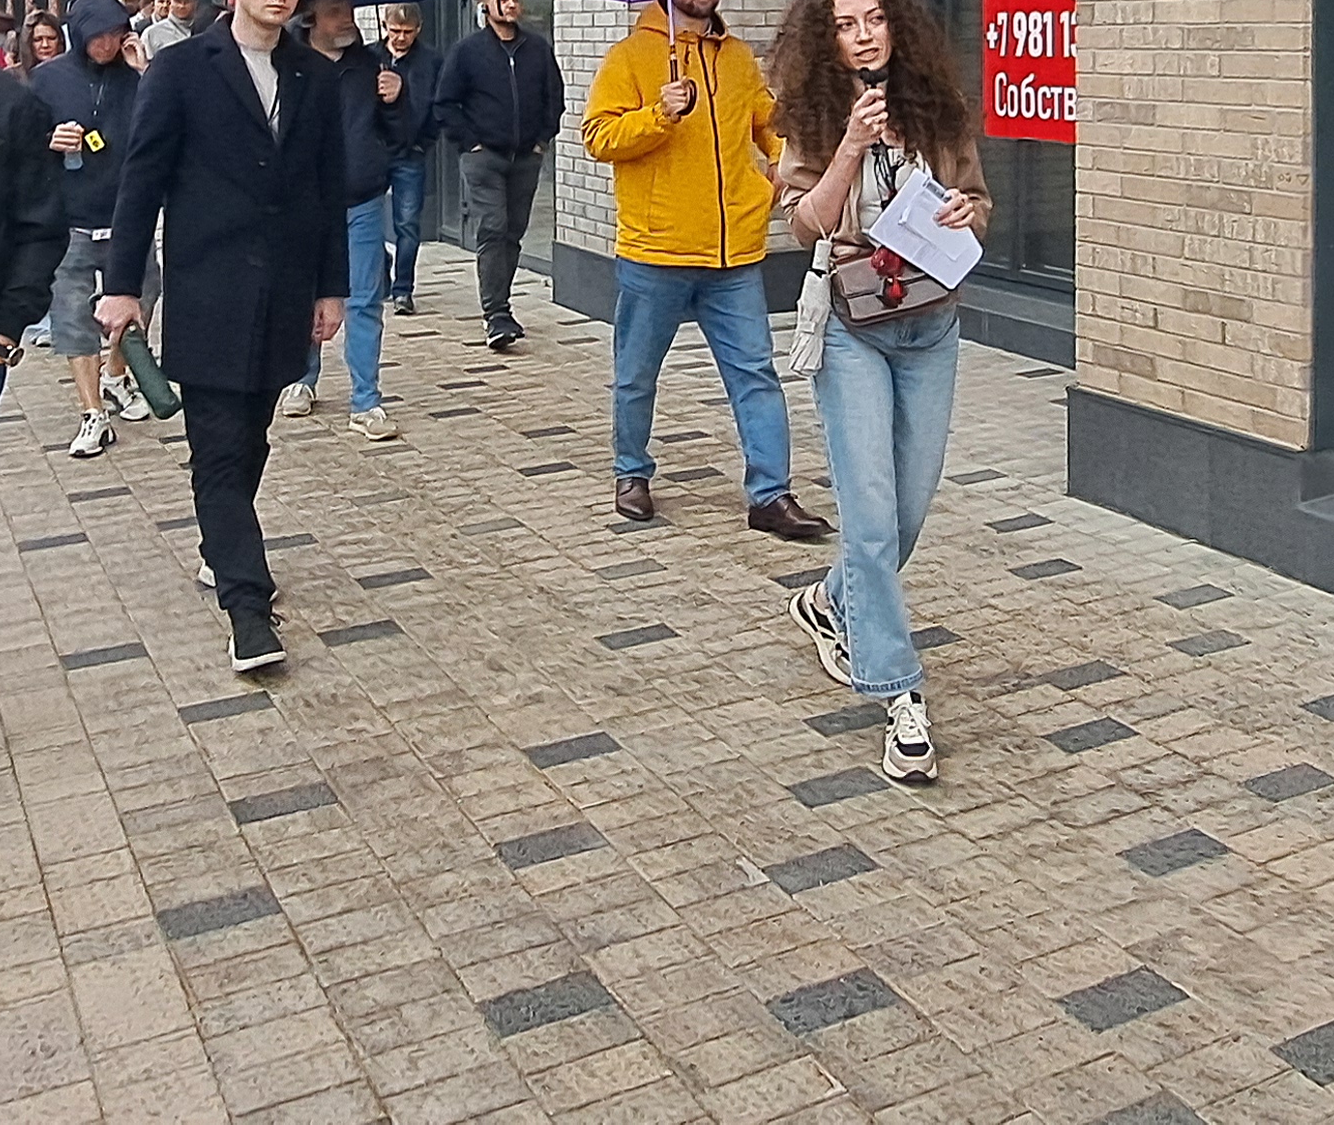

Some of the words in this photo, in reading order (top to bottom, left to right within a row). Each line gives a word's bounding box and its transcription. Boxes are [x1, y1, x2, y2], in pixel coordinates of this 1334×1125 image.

[986, 11, 1008, 57] +7
[1012, 10, 1053, 58] 981
[994, 71, 1077, 122] Собств
